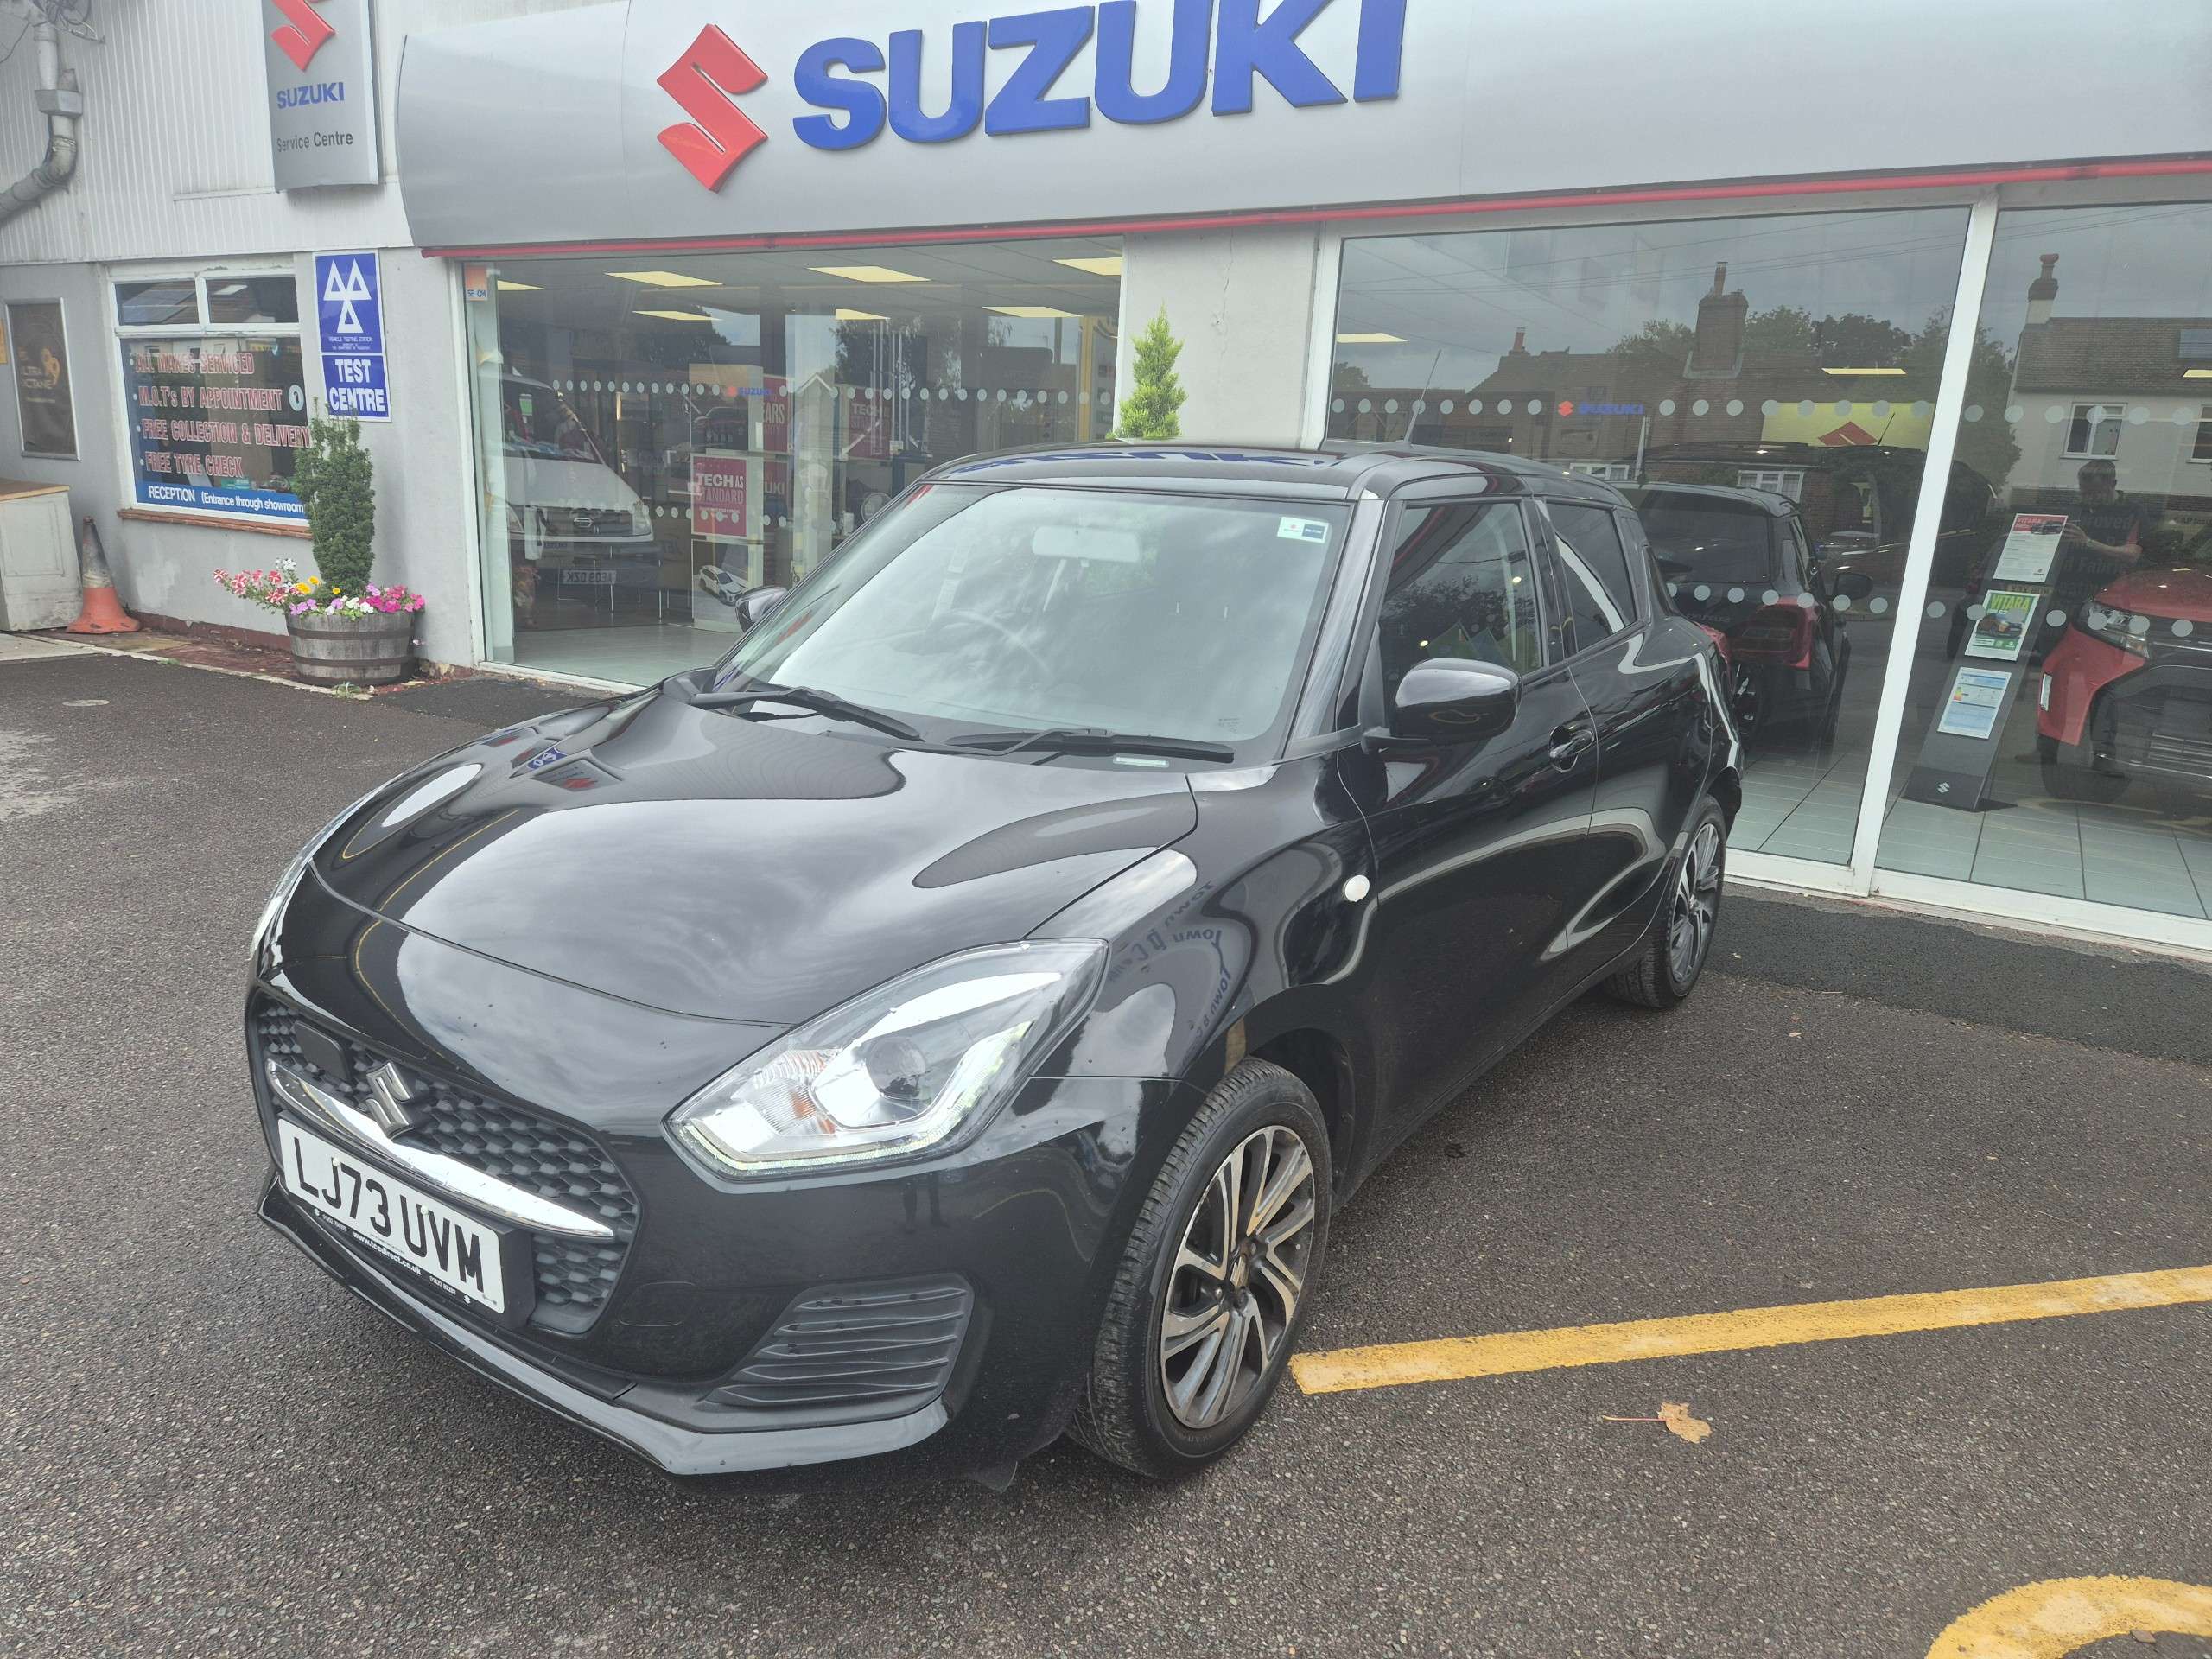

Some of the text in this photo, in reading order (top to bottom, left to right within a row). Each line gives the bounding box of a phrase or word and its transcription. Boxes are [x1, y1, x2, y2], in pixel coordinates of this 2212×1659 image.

[792, 0, 1407, 150] SUZUKI
[276, 81, 345, 109] SUZUKI
[276, 131, 353, 152] Service Centre
[135, 352, 255, 375] ALL MAKES SERVICED
[334, 359, 372, 383] TEST
[138, 385, 283, 410] M.O.T's BY APPOINTMENT
[329, 387, 386, 412] CENTRE
[762, 402, 785, 424] ARS
[142, 418, 312, 448] FREE COLLECTION & DELIVERY
[145, 451, 243, 478] FREE TYRE CHECK
[696, 473, 744, 489] TECH AS
[149, 485, 195, 502] RECEPTION
[201, 492, 234, 507] (Entrance
[235, 496, 264, 511] through
[1990, 593, 2031, 612] VITARA
[294, 1136, 486, 1294] LJ73 UVM
[352, 1231, 422, 1276] www.tccdirect.co.uk
